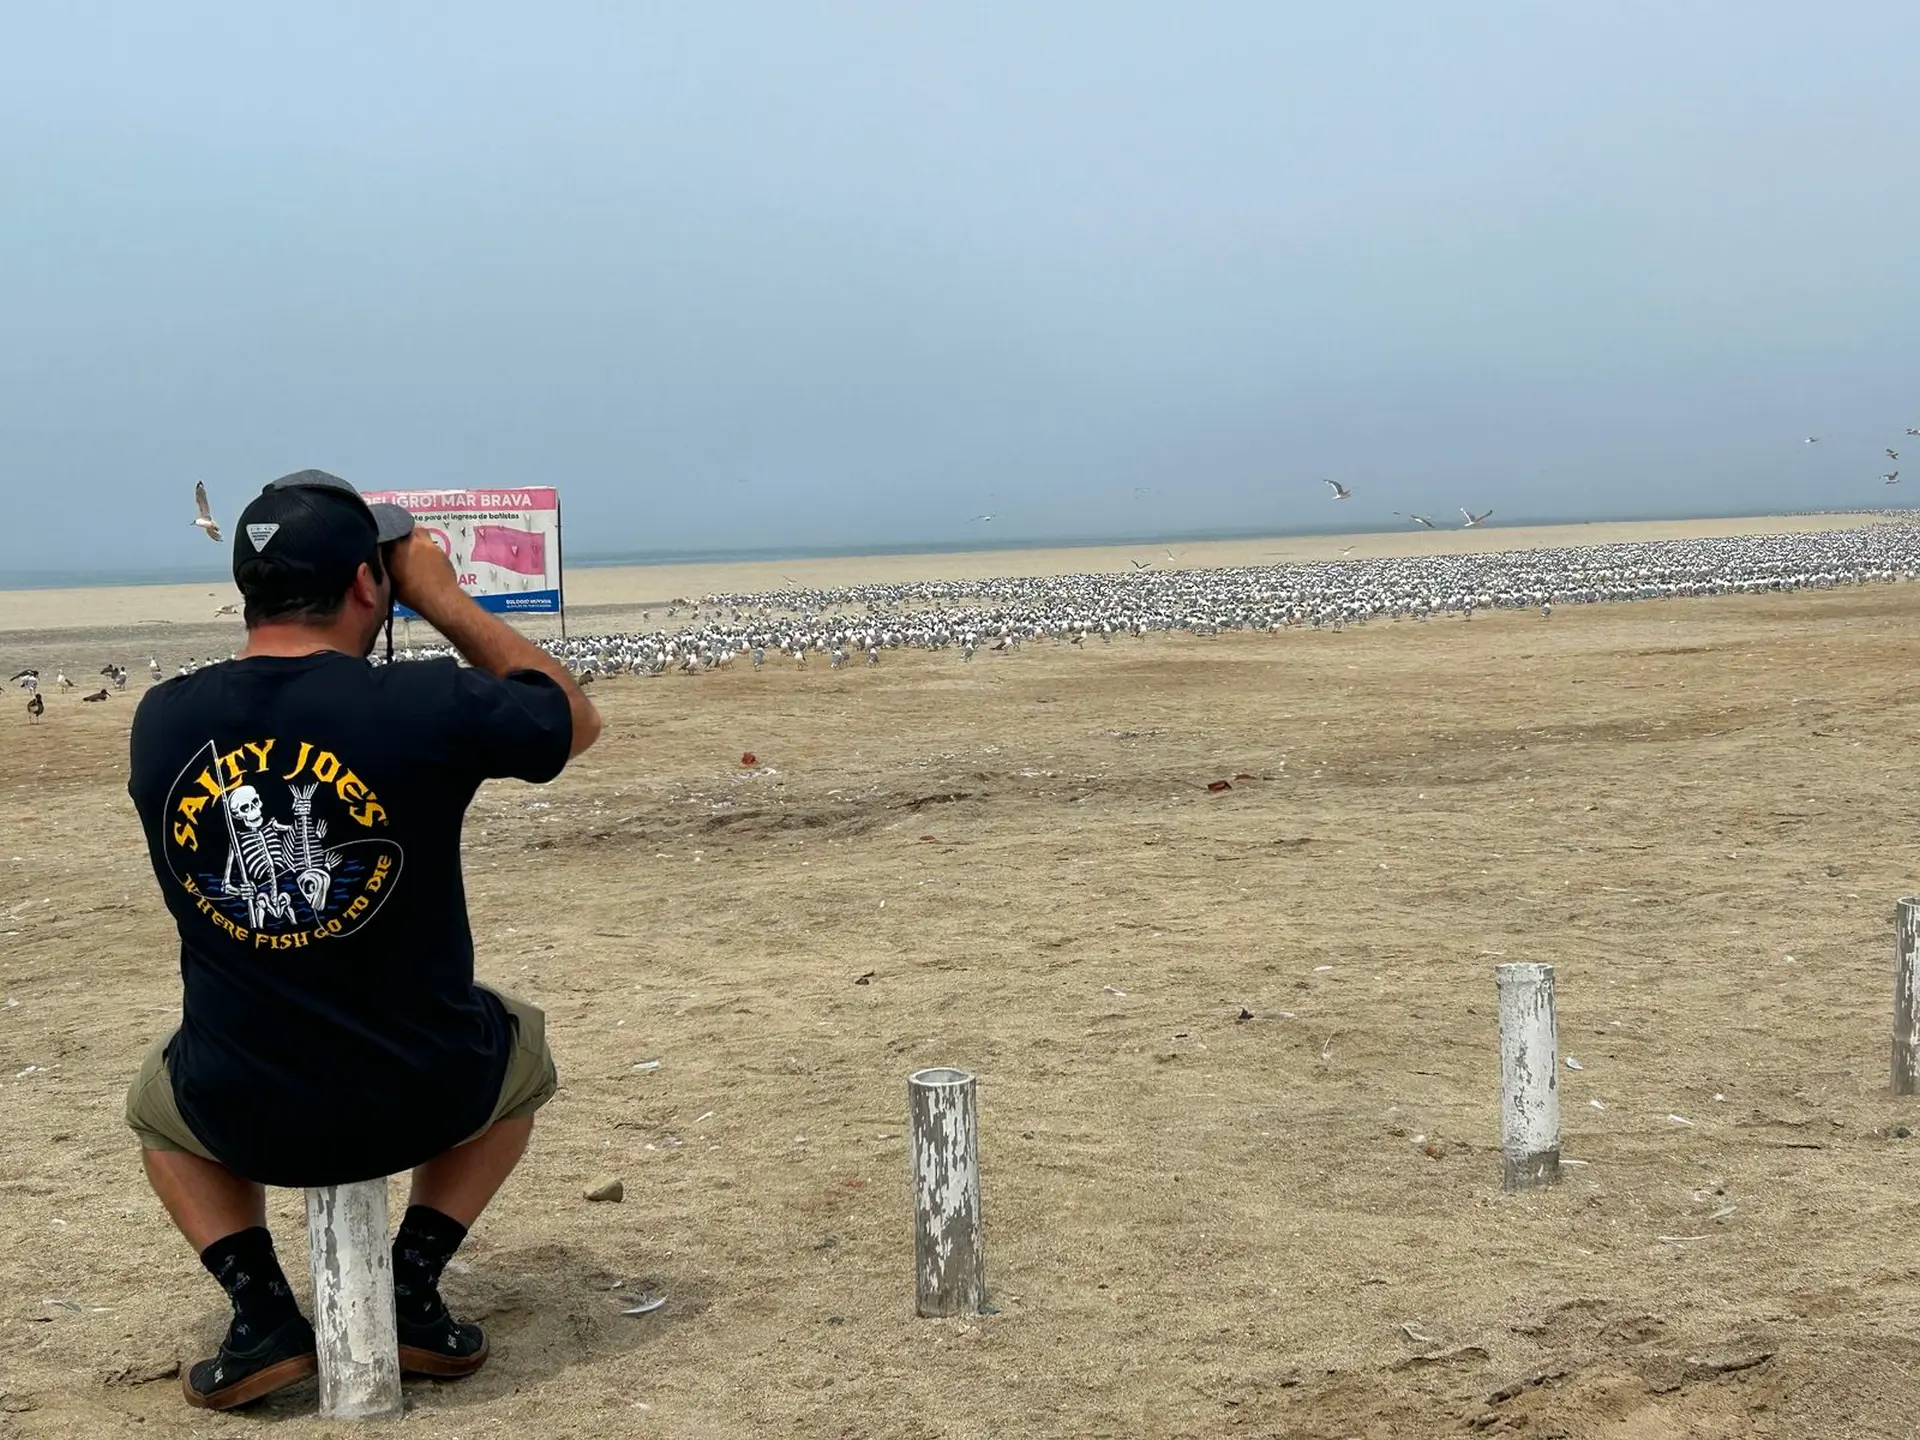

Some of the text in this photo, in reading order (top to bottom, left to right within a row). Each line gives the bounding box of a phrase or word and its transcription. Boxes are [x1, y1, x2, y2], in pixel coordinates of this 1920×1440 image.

[425, 514, 441, 522] para
[451, 512, 477, 521] ingreso
[479, 511, 487, 519] de
[442, 495, 476, 508] MAR
[480, 493, 532, 507] BRAVA
[174, 739, 276, 852] SALTY
[185, 854, 392, 950] WHERE FISH GO TO DIE
